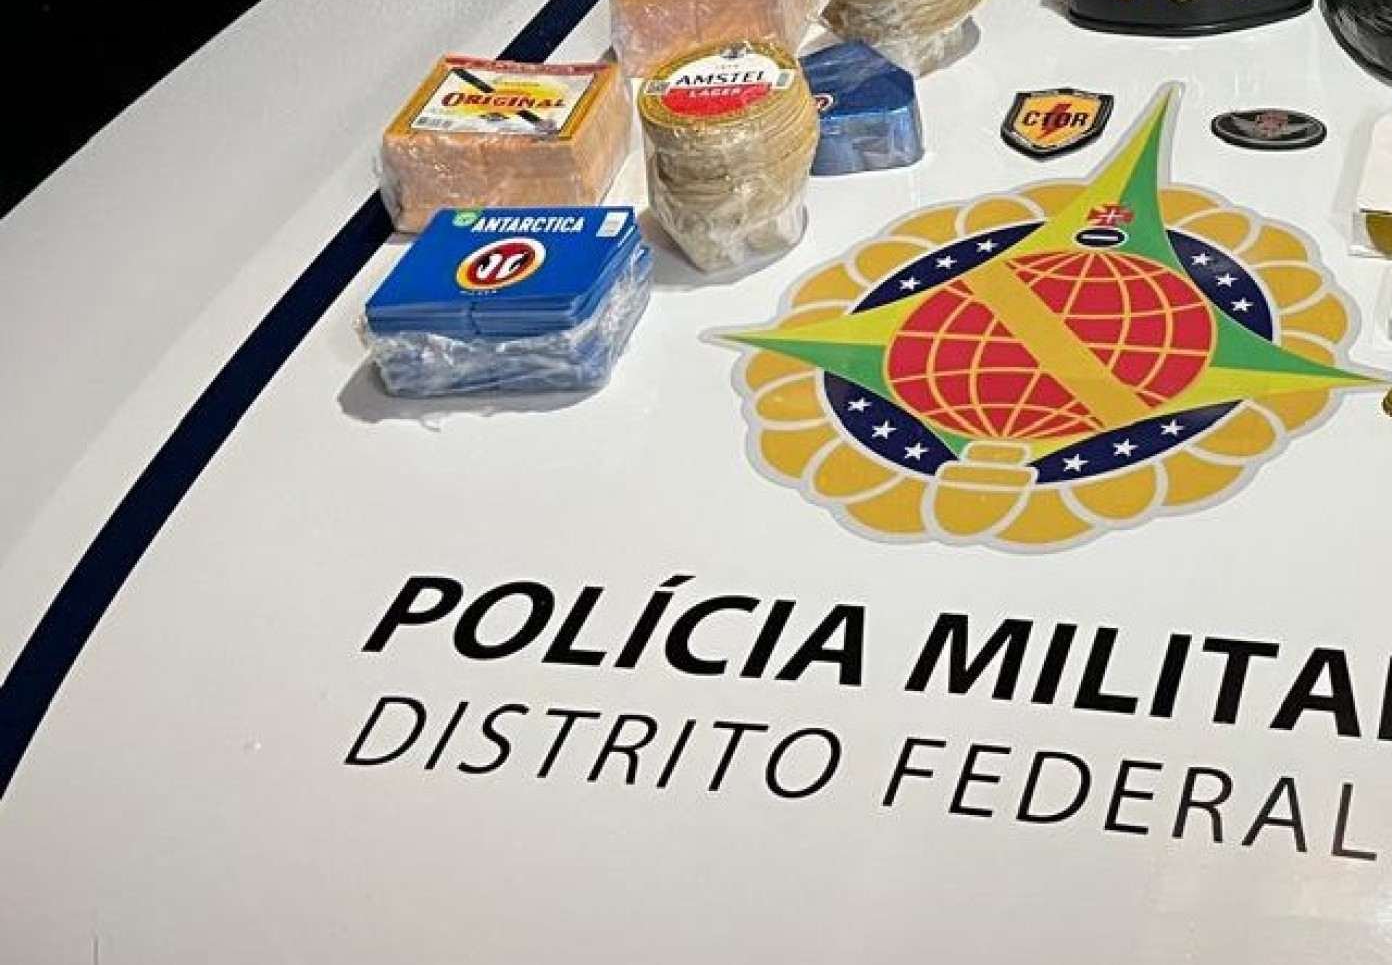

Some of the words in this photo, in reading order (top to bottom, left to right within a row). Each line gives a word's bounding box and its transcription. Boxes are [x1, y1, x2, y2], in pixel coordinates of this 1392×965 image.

[676, 70, 765, 85] AMSTEL
[441, 92, 567, 107] ORIGINAL
[1022, 110, 1090, 131] CTOR
[470, 216, 585, 233] ANTARCTICA
[363, 576, 865, 687] POLÍCIA
[345, 697, 840, 799] DISTRITO
[883, 739, 1377, 861] FEDERAL
